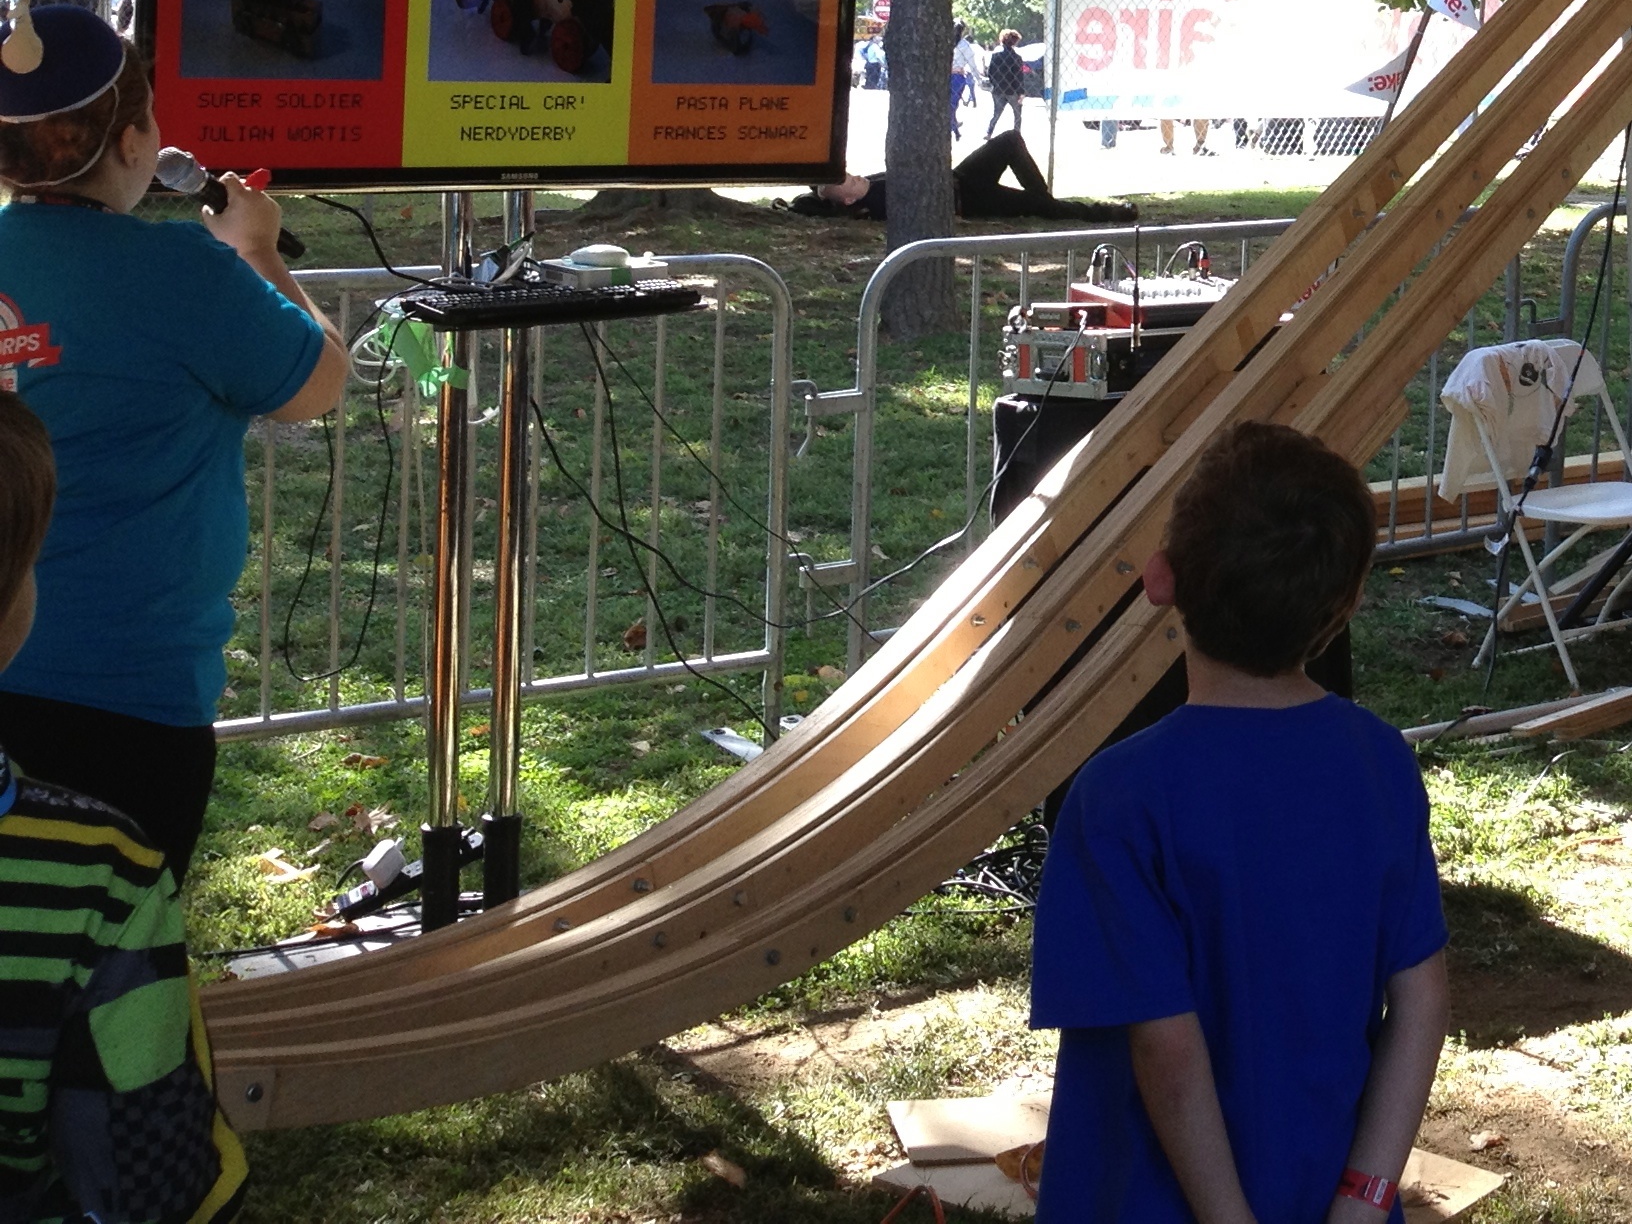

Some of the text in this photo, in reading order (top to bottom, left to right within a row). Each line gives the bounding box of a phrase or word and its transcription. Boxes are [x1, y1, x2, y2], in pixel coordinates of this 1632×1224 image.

[198, 92, 363, 109] SUPER SOLDIER
[450, 94, 586, 111] SPECIAL CAR!
[676, 96, 791, 111] PASTA PLANE
[197, 126, 363, 143] JULIAN WORTIS
[459, 125, 577, 142] NERDYDERBY
[653, 125, 809, 142] FRANCES SCHWARZ
[0, 332, 41, 356] RPS
